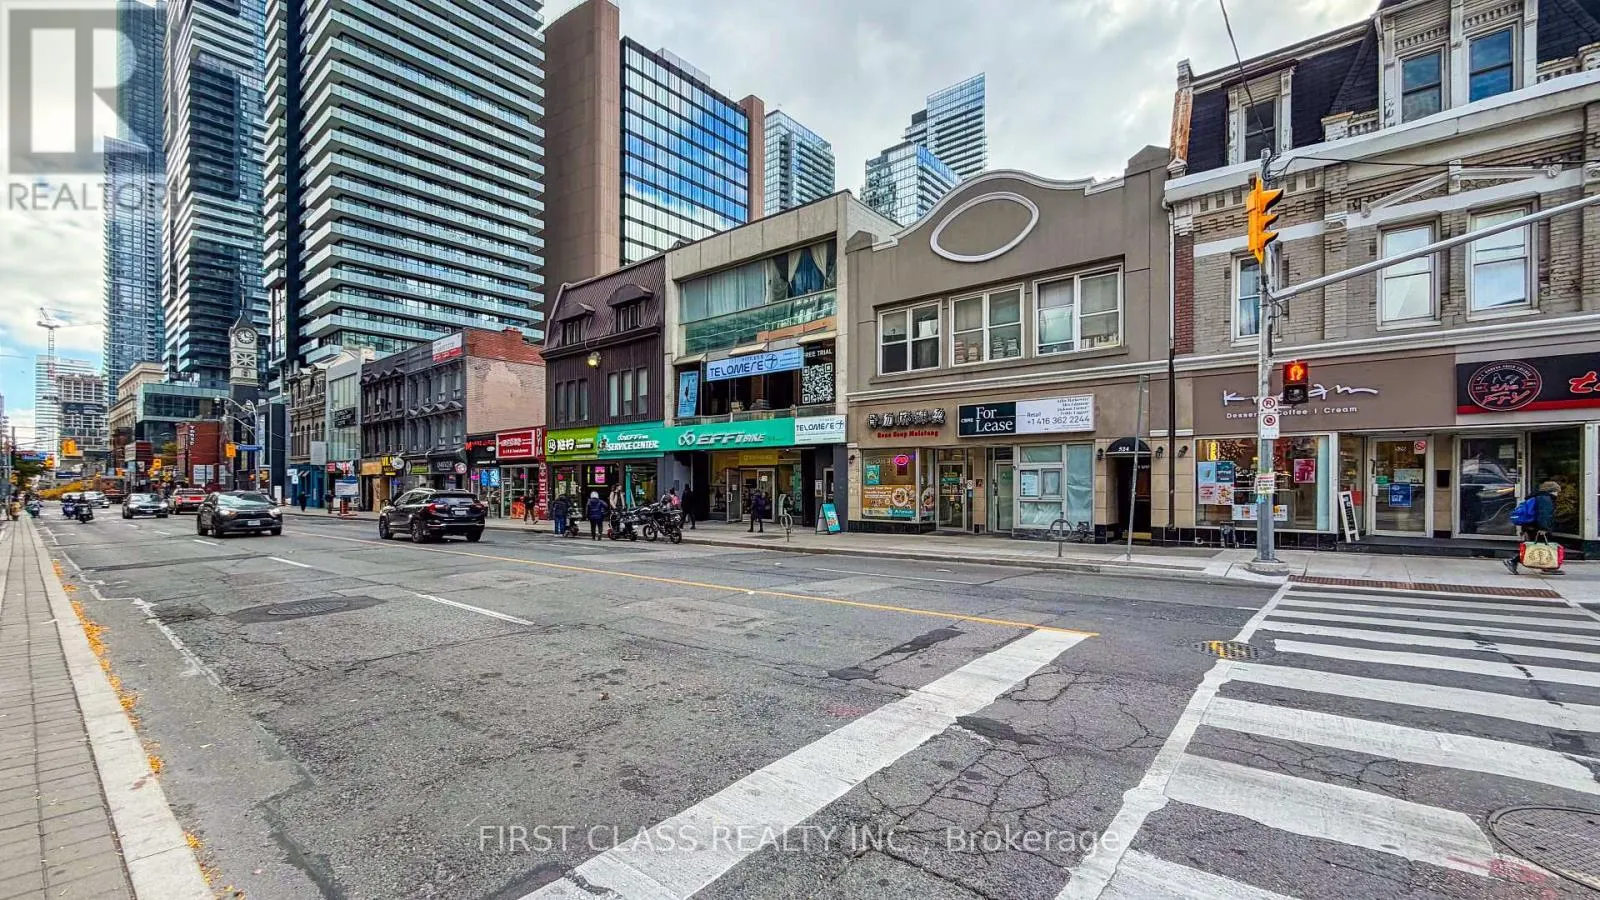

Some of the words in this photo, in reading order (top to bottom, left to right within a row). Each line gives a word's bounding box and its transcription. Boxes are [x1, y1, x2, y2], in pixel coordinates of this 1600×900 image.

[817, 348, 832, 357] TRIAL
[975, 406, 998, 420] For
[1323, 406, 1357, 414] Cream
[1052, 416, 1068, 424] 362
[1068, 415, 1090, 424] 2244
[975, 419, 1013, 432] Lease
[608, 441, 633, 451] SERVICE
[633, 440, 660, 449] CENTER
